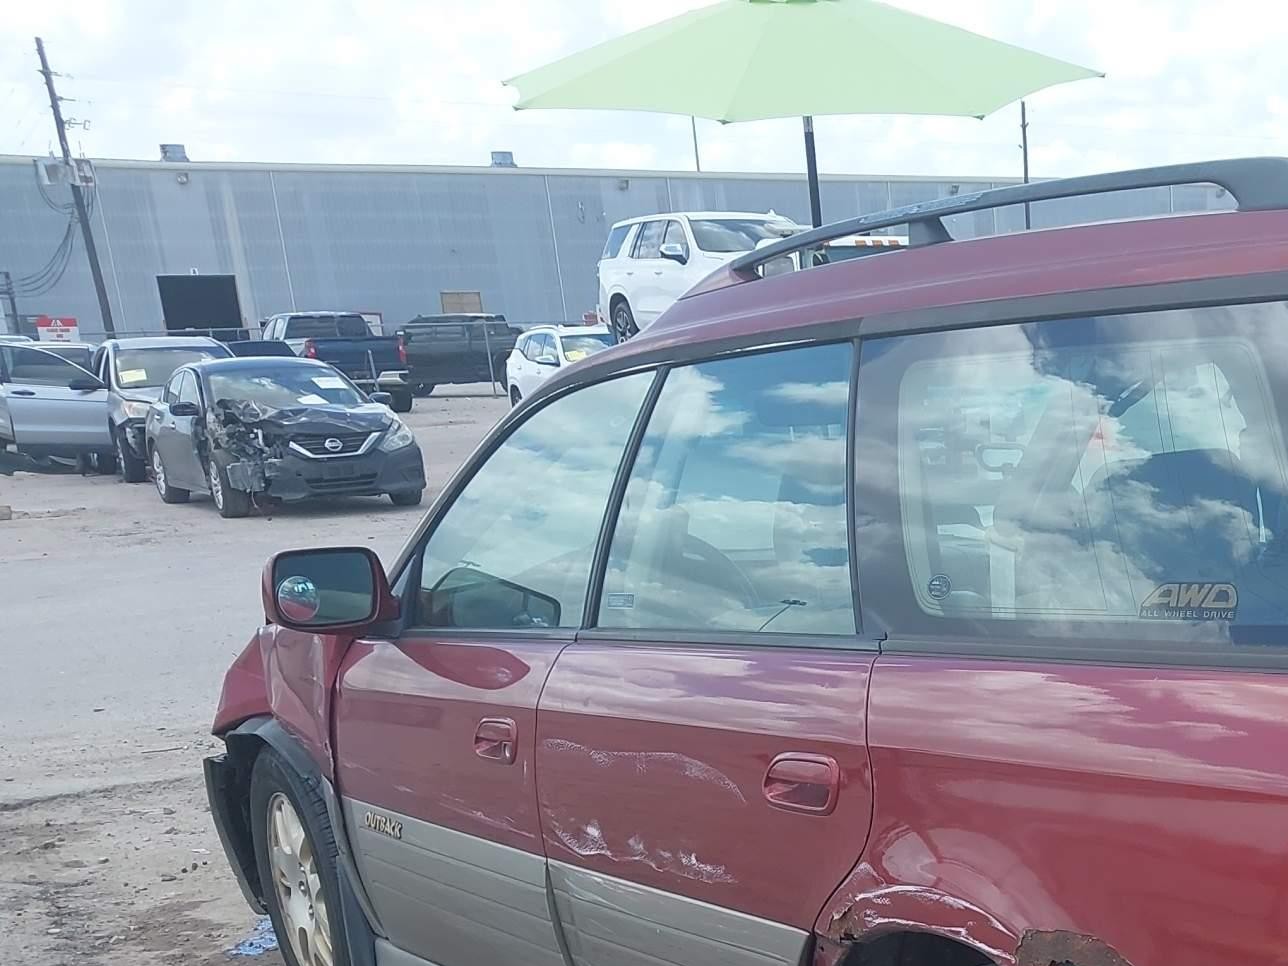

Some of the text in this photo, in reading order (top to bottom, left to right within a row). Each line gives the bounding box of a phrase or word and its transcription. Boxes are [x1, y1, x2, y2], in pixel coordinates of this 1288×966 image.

[1141, 583, 1238, 608] AWD
[1139, 610, 1236, 619] ALL WHEEL DRIVE
[364, 811, 403, 840] OUTBACK
